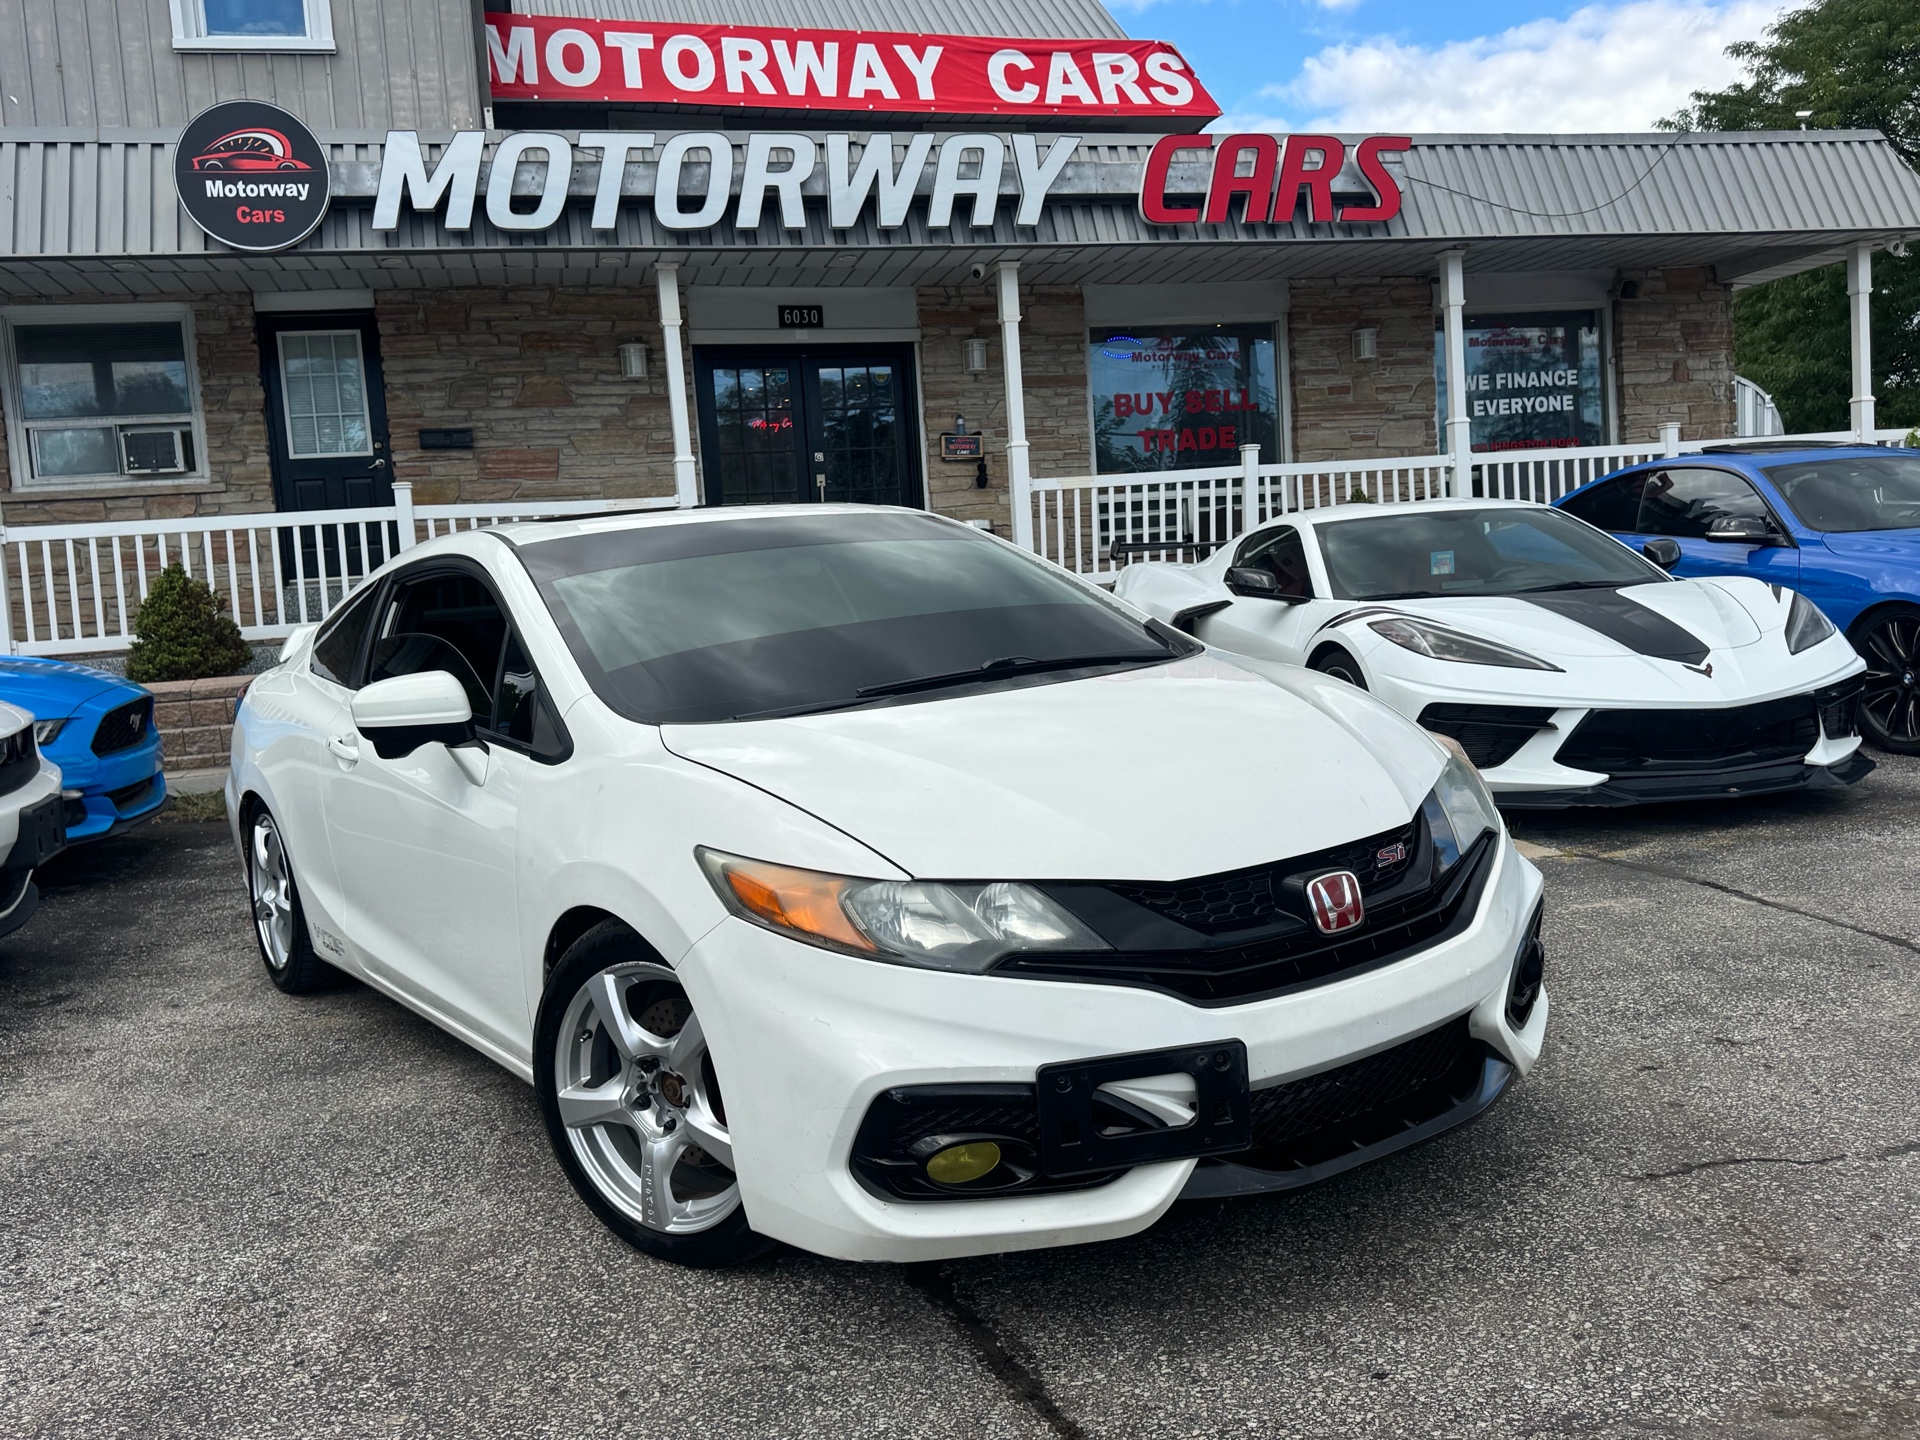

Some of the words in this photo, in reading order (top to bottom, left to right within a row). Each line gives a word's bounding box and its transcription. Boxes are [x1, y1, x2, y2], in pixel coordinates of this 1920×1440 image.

[485, 24, 944, 101] MOTORWAY
[986, 49, 1194, 106] CARS
[205, 180, 310, 201] Motorway
[372, 130, 1083, 232] MOTORWAY
[1138, 133, 1413, 226] CARS
[236, 206, 286, 224] Cars
[784, 309, 818, 324] 6030
[1468, 336, 1531, 348] Motorway
[1131, 350, 1200, 364] Motorway
[1206, 349, 1241, 361] Cars
[1465, 374, 1490, 391] WE
[1496, 369, 1578, 390] FINANCE
[1113, 390, 1176, 418] BUY
[1184, 388, 1258, 414] SELL
[1473, 394, 1574, 417] EVERYONE
[1137, 425, 1237, 453] TRADE
[1551, 436, 1580, 448] ROAD
[1377, 841, 1406, 868] Si
